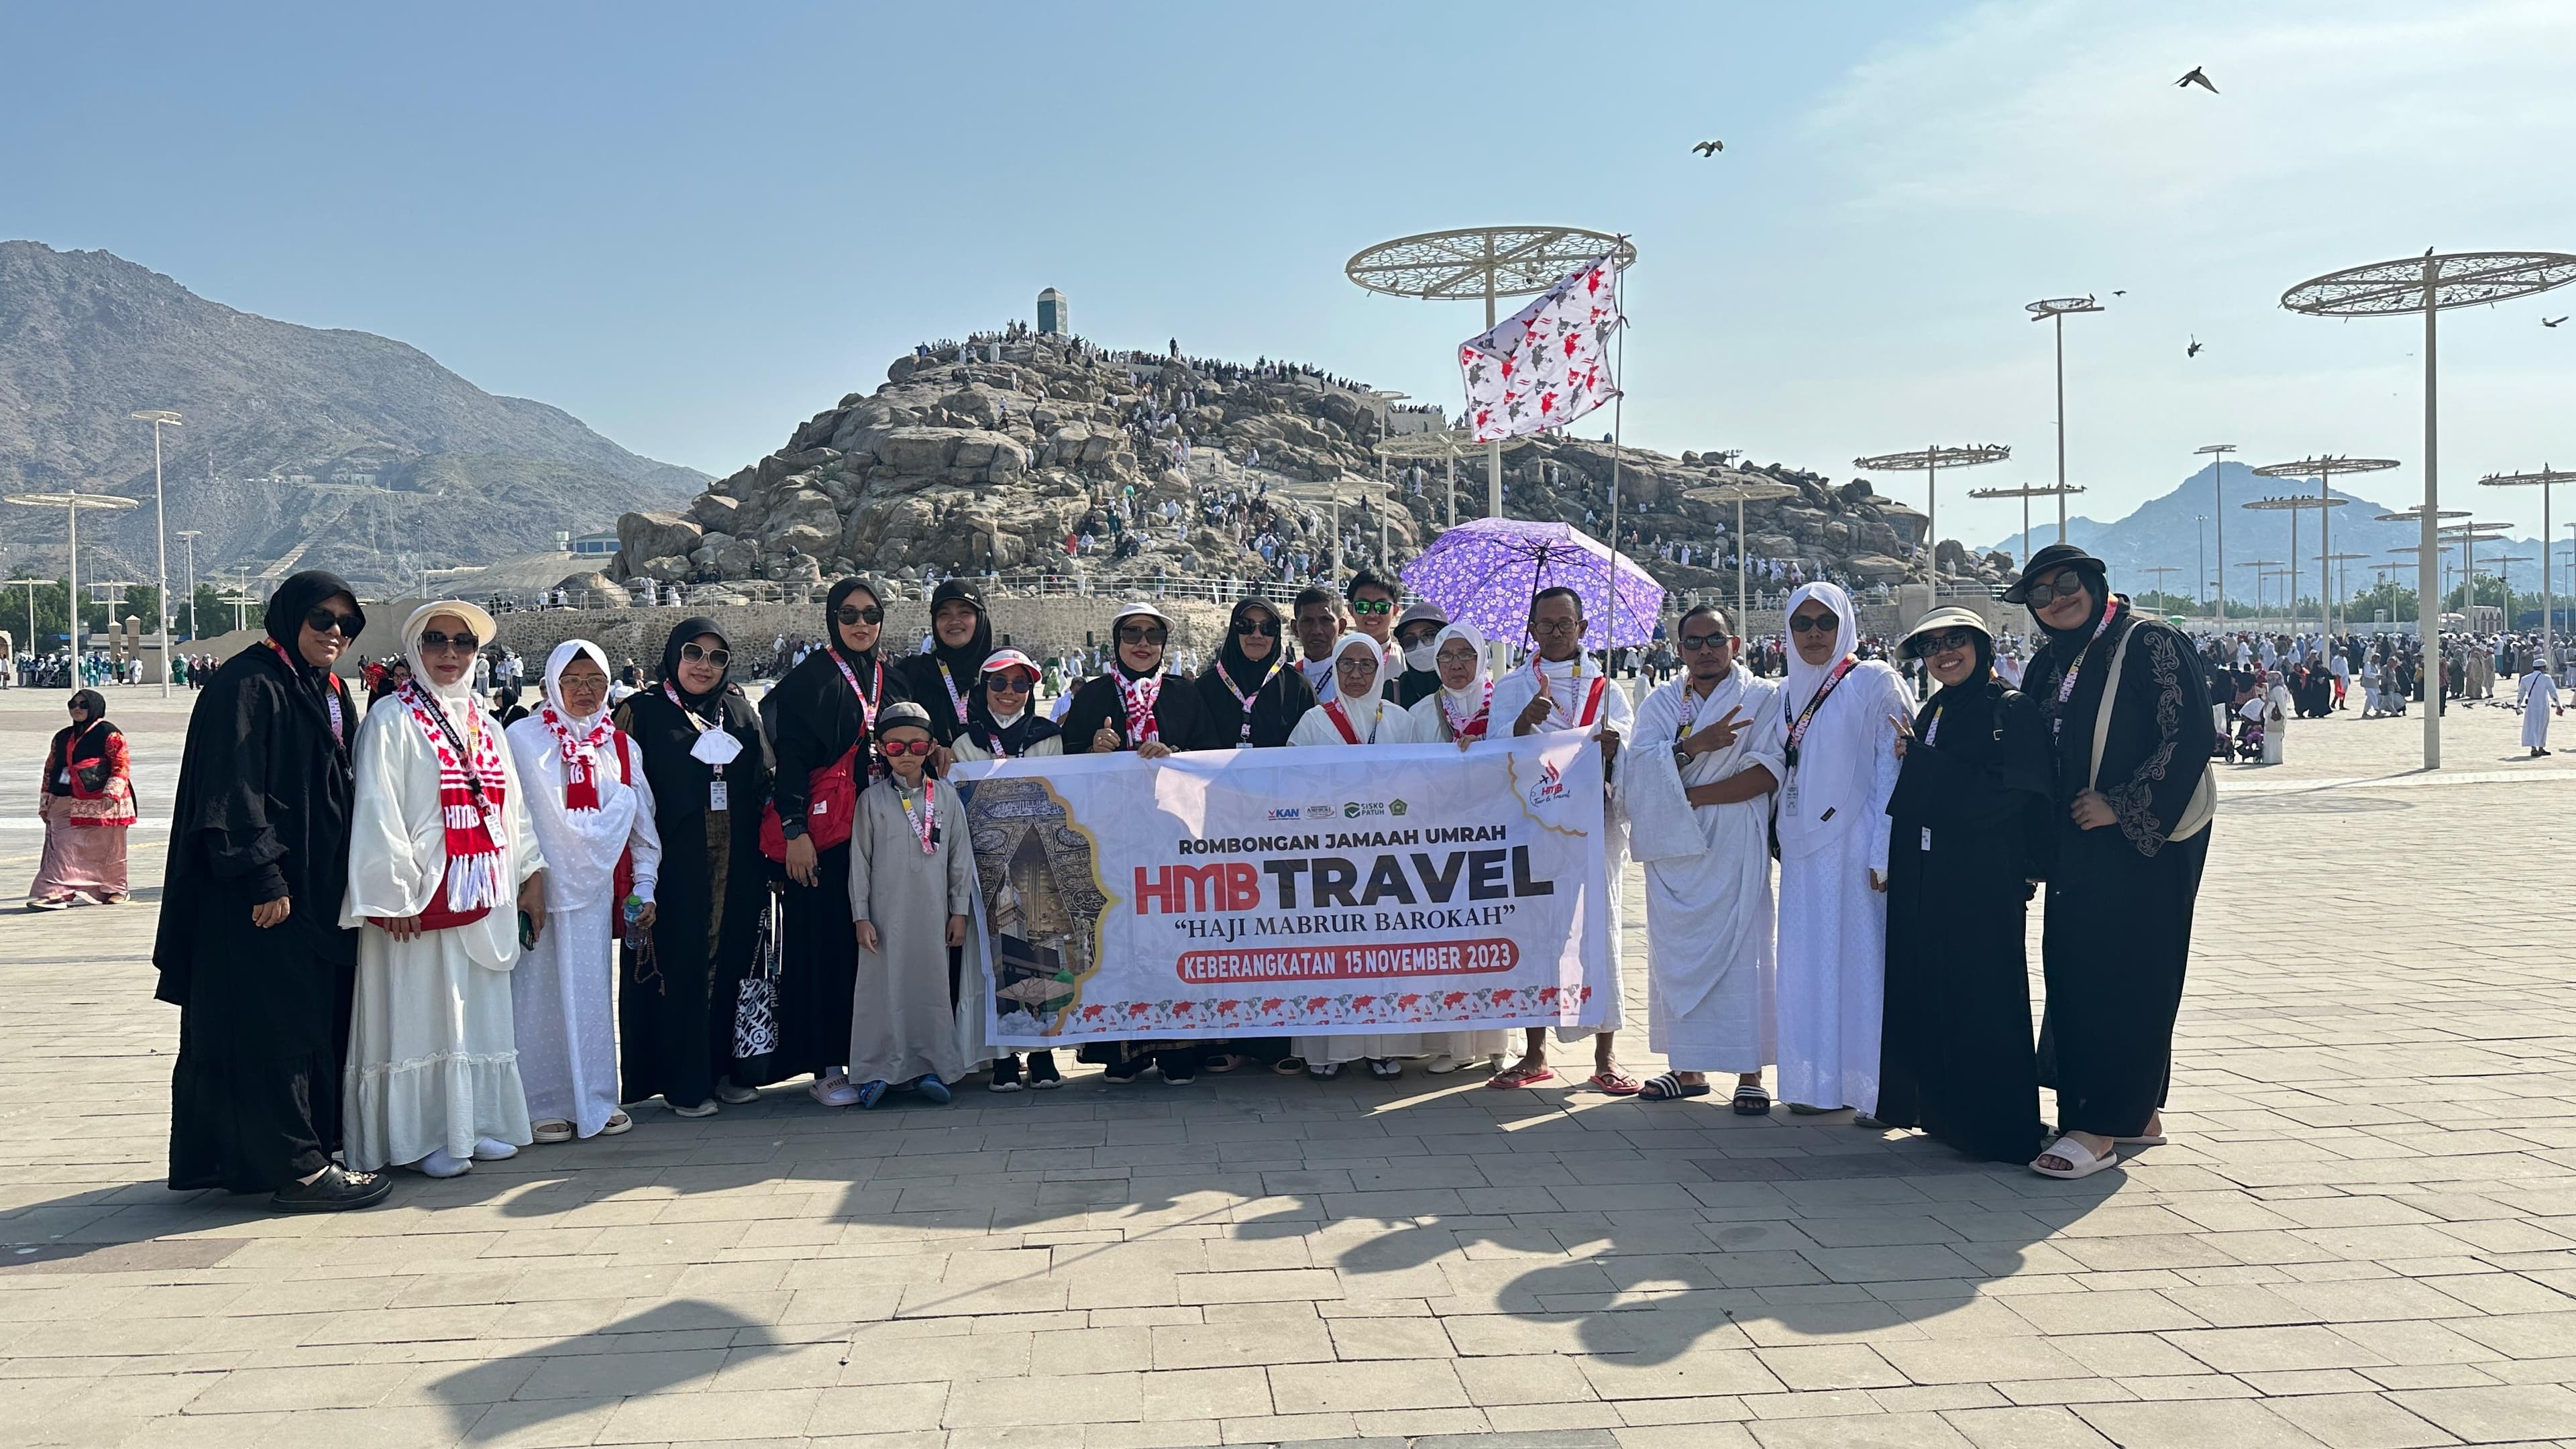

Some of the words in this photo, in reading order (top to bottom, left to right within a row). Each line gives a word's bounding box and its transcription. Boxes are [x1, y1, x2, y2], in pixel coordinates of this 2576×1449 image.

[443, 804, 480, 829] HMB
[1179, 835, 1320, 855] ROMBONGAN
[1326, 829, 1419, 849] JAMAAH
[1426, 824, 1506, 844] UMRAH
[1135, 862, 1260, 914] HMB
[1263, 845, 1554, 909] TRAVEL
[1255, 913, 1368, 936] MABRUR
[1184, 951, 1336, 979] KEBERANGKATAN
[1344, 951, 1362, 973] 15
[1364, 946, 1462, 973] NOVEMBER
[1467, 943, 1511, 968] 2023
[769, 983, 779, 1008] PINK
